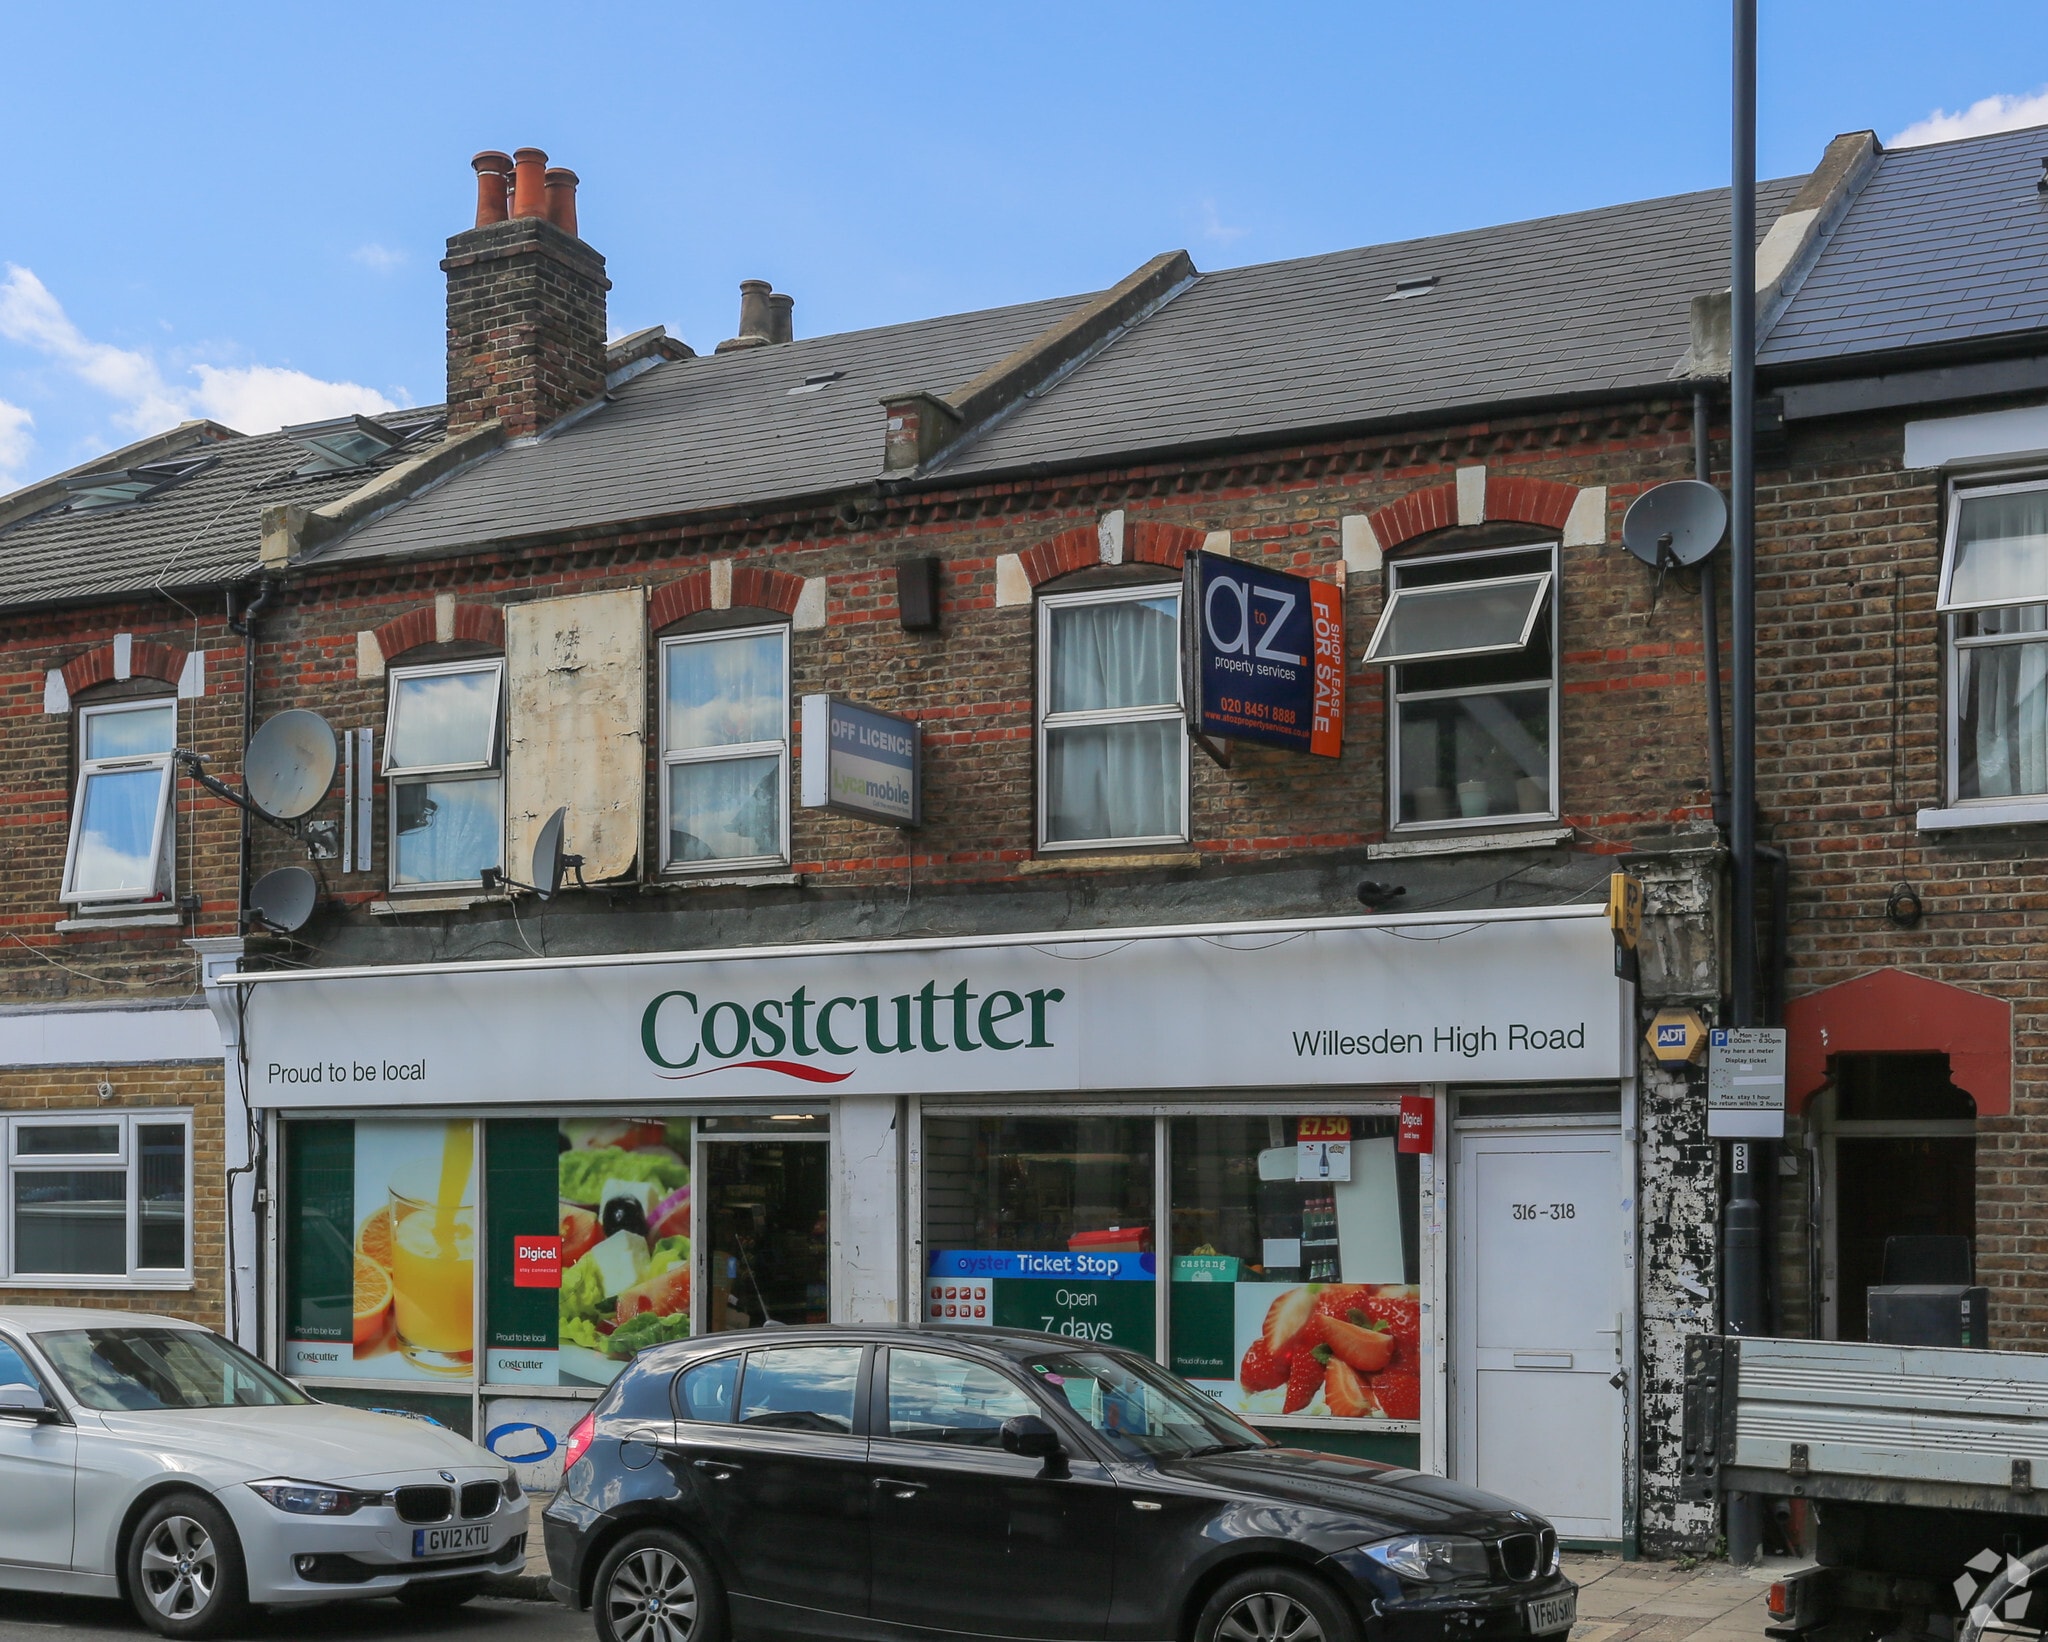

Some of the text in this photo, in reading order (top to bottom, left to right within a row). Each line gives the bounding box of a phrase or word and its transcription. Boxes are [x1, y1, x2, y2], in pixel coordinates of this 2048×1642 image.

[1253, 608, 1267, 625] to
[1215, 656, 1296, 681] property services
[1313, 601, 1332, 733] FOR SALE
[1330, 623, 1341, 718] SHOP LEASE
[1220, 697, 1296, 724] 020 8451 8888
[1204, 710, 1310, 738] www.atozpropertyservices.co.uk
[831, 718, 913, 757] OFF LICENCE
[833, 767, 910, 806] Lycamobile
[641, 978, 1066, 1069] Costcutter
[1292, 1022, 1585, 1058] Willesden High Road
[1657, 1027, 1686, 1043] ADT
[1715, 1031, 1725, 1046] P
[268, 1058, 426, 1084] Proud to be local
[1299, 1117, 1348, 1136] £7.50
[1402, 1112, 1423, 1128] Digicel
[519, 1246, 557, 1262] Digicel
[957, 1254, 1120, 1276] oyster Ticket Stop
[1180, 1258, 1226, 1271] castang
[1055, 1288, 1097, 1309] Open
[295, 1326, 342, 1336] Proud to be local
[495, 1332, 547, 1342] Proud to be local
[1040, 1315, 1113, 1342] 7 days
[297, 1351, 339, 1362] Costcutter
[498, 1358, 544, 1369] Costcutter
[1177, 1356, 1193, 1365] Proud
[1193, 1357, 1200, 1365] of
[1208, 1357, 1223, 1366] offers
[430, 1526, 489, 1549] GV12 KTU
[1532, 1601, 1558, 1628] YF60
